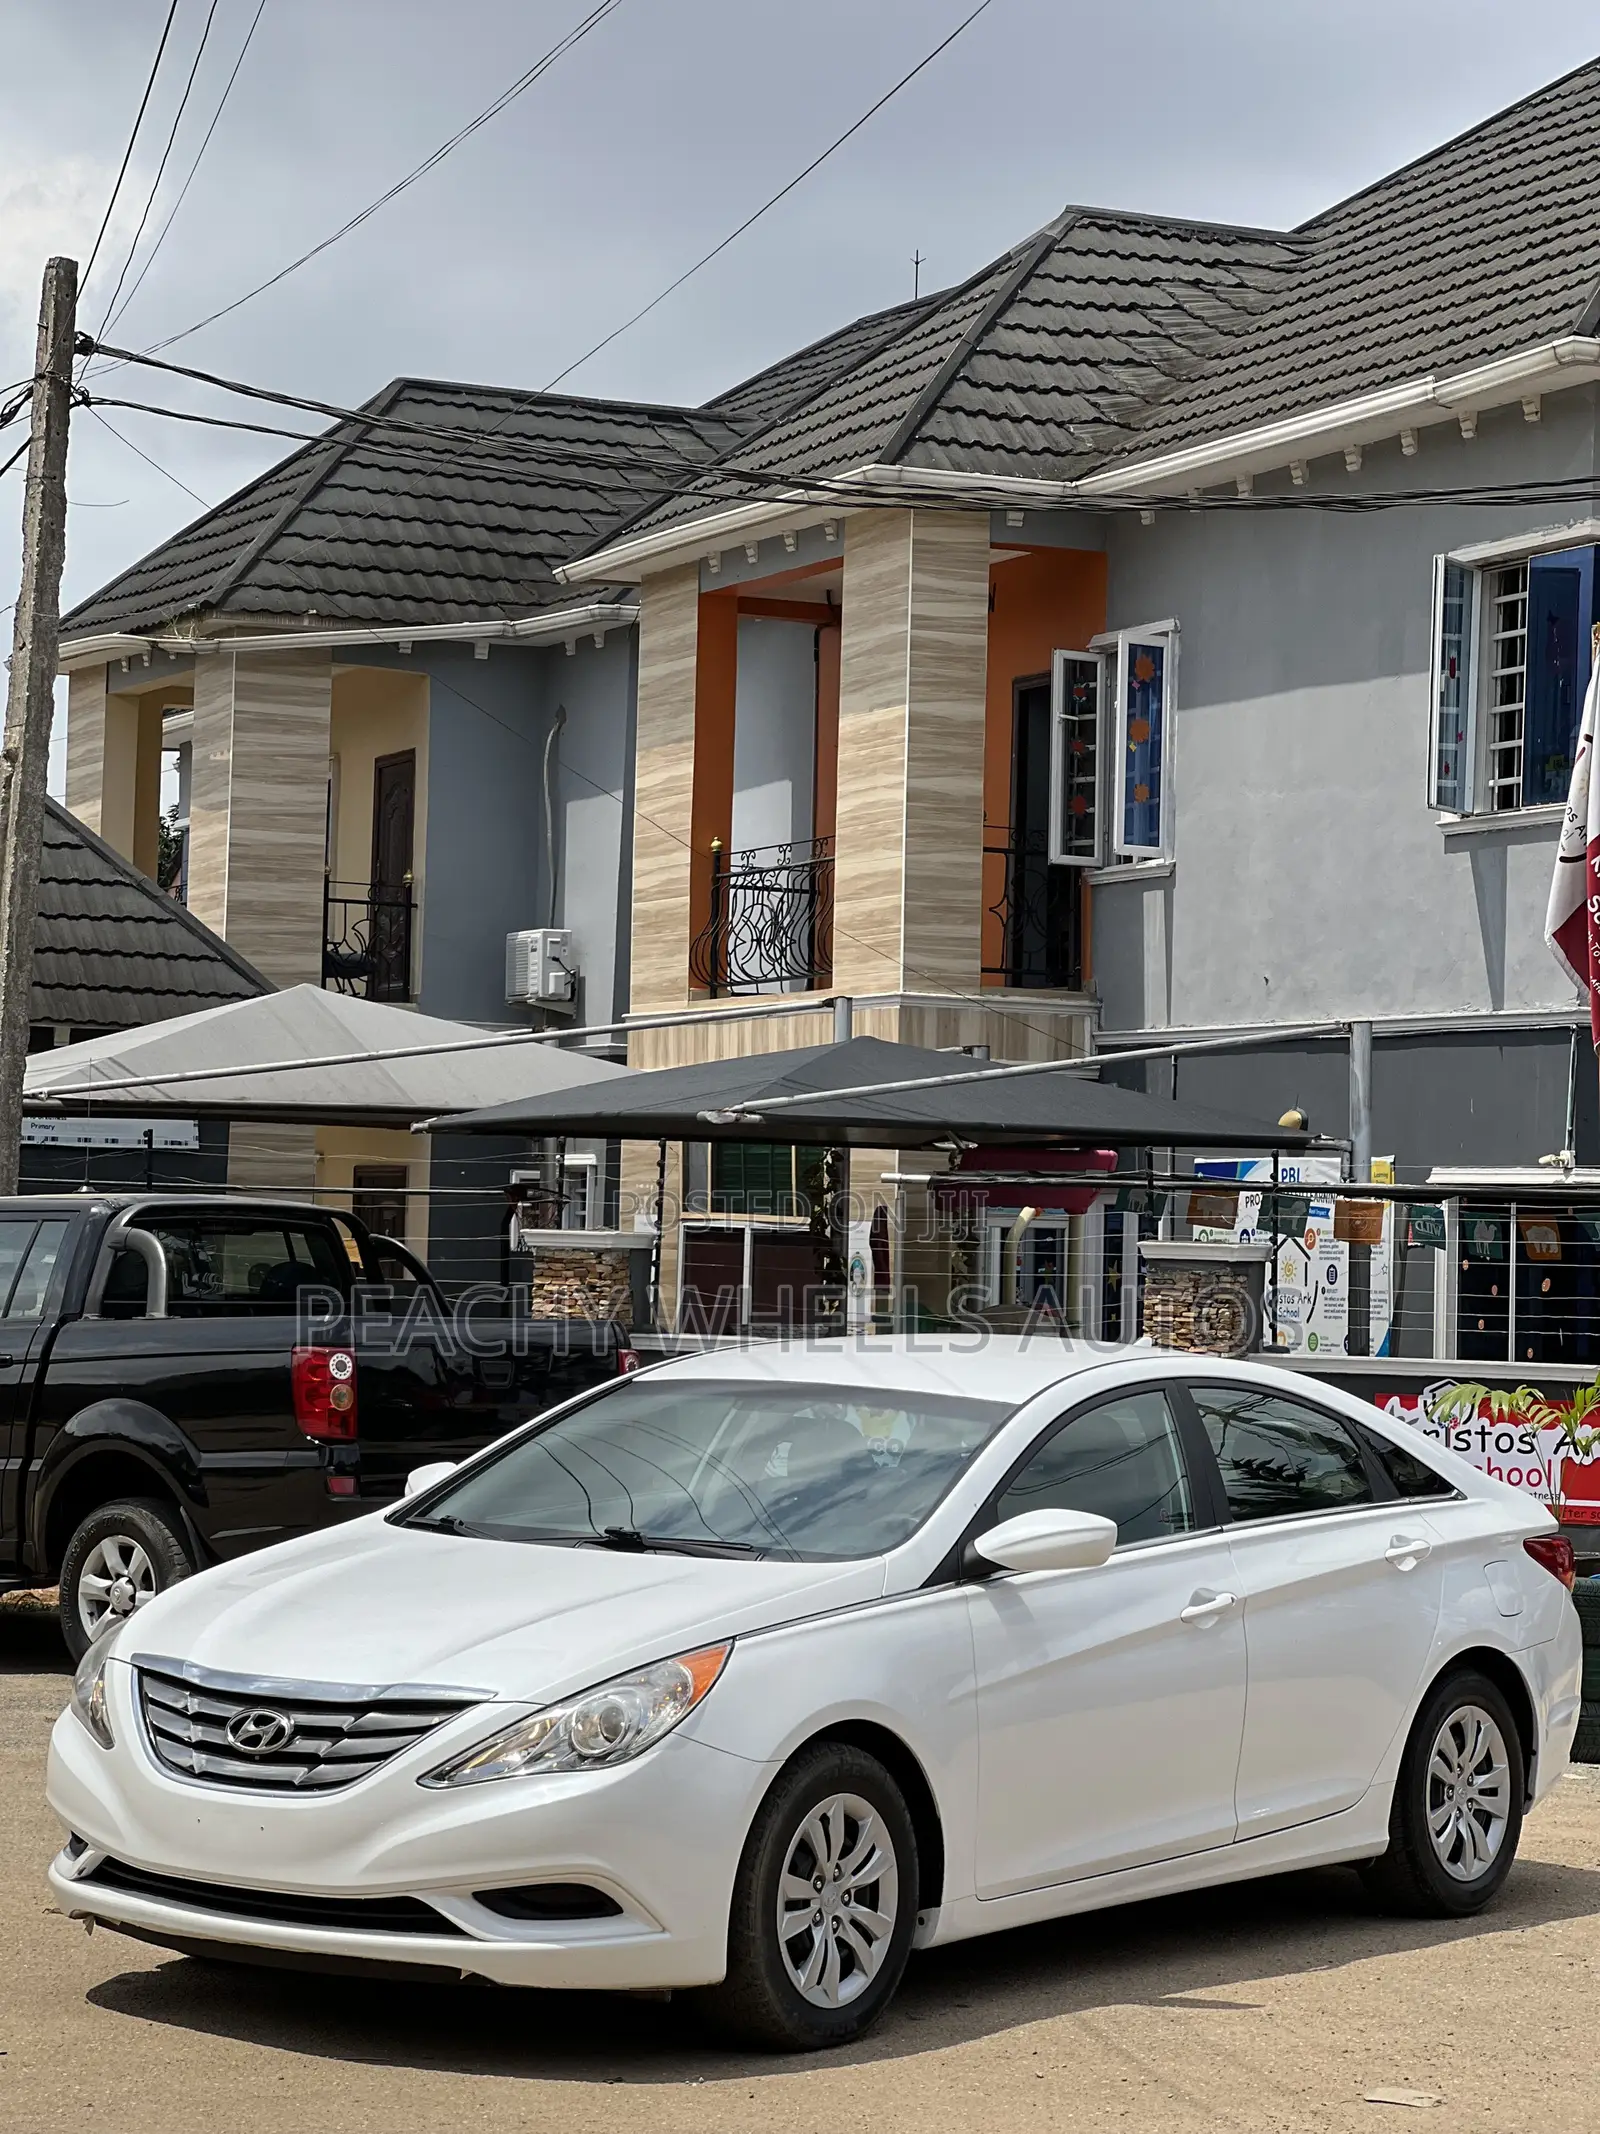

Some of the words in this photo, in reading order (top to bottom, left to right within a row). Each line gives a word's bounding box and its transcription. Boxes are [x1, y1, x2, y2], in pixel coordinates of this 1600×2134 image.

[31, 1122, 56, 1131] Primary
[1297, 1291, 1312, 1305] Ark
[1278, 1307, 1299, 1318] School
